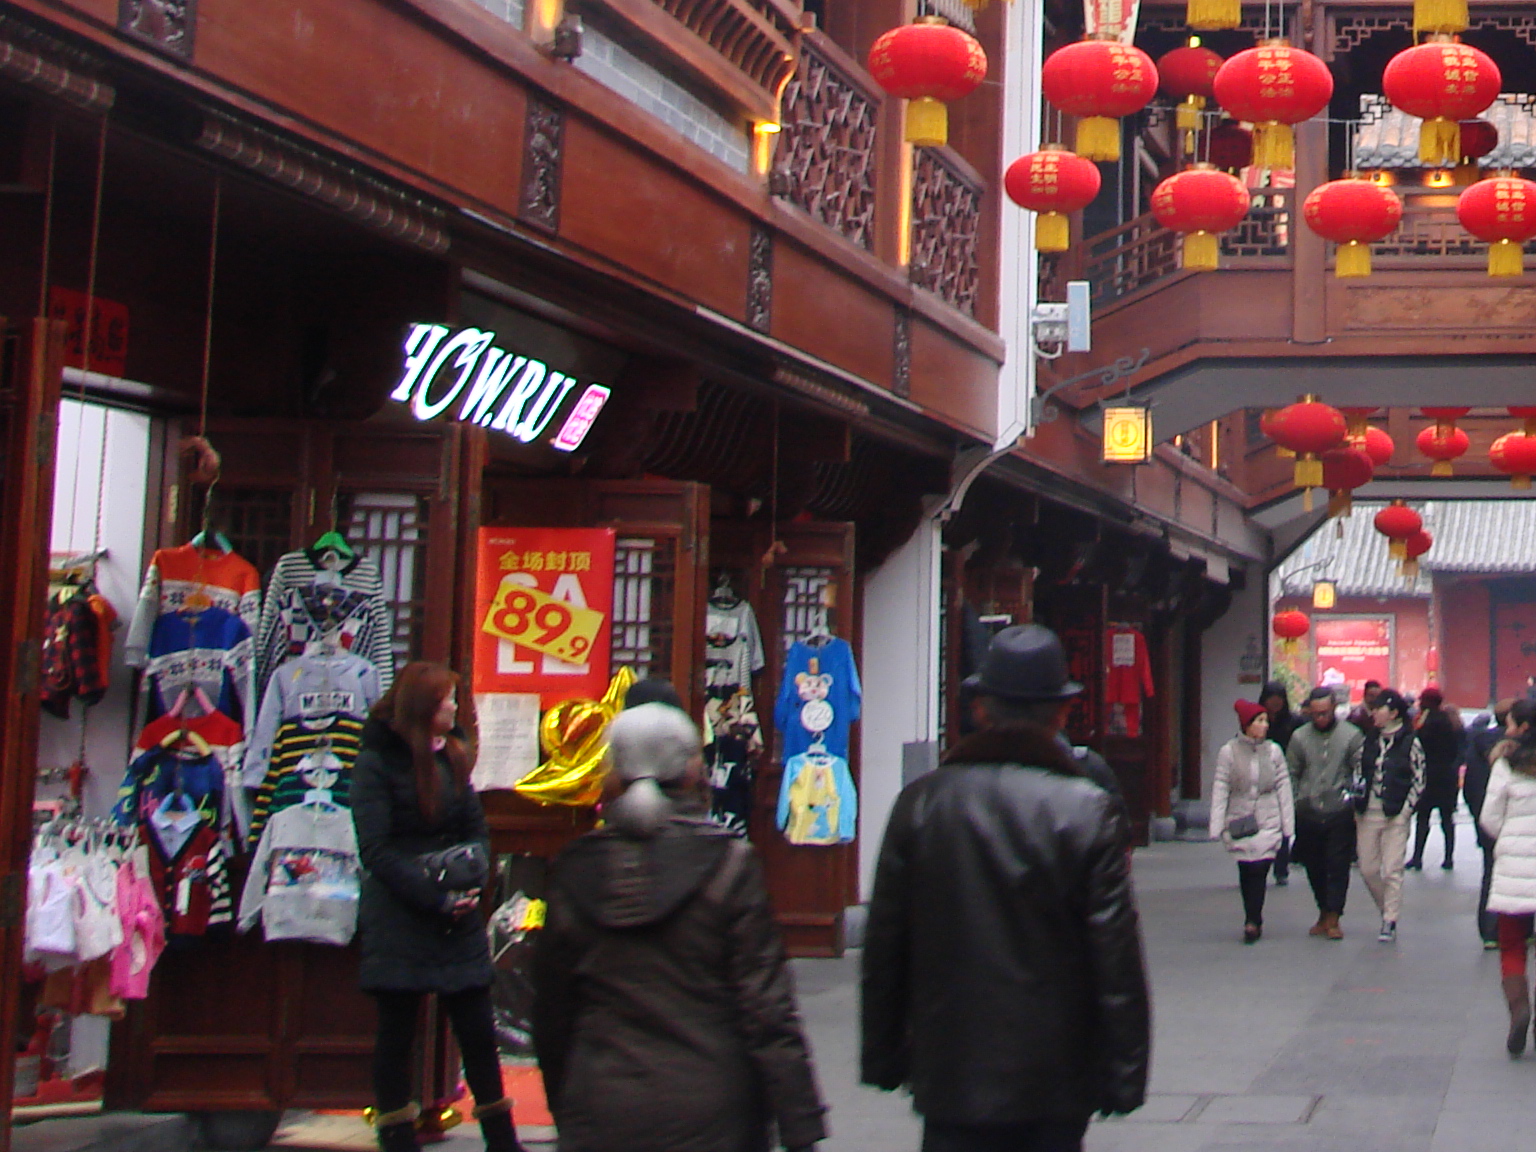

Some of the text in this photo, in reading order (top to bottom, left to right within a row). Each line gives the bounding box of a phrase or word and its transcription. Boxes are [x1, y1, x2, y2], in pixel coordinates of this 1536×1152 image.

[499, 551, 591, 571] 全场封顶
[493, 590, 589, 657] 89.9
